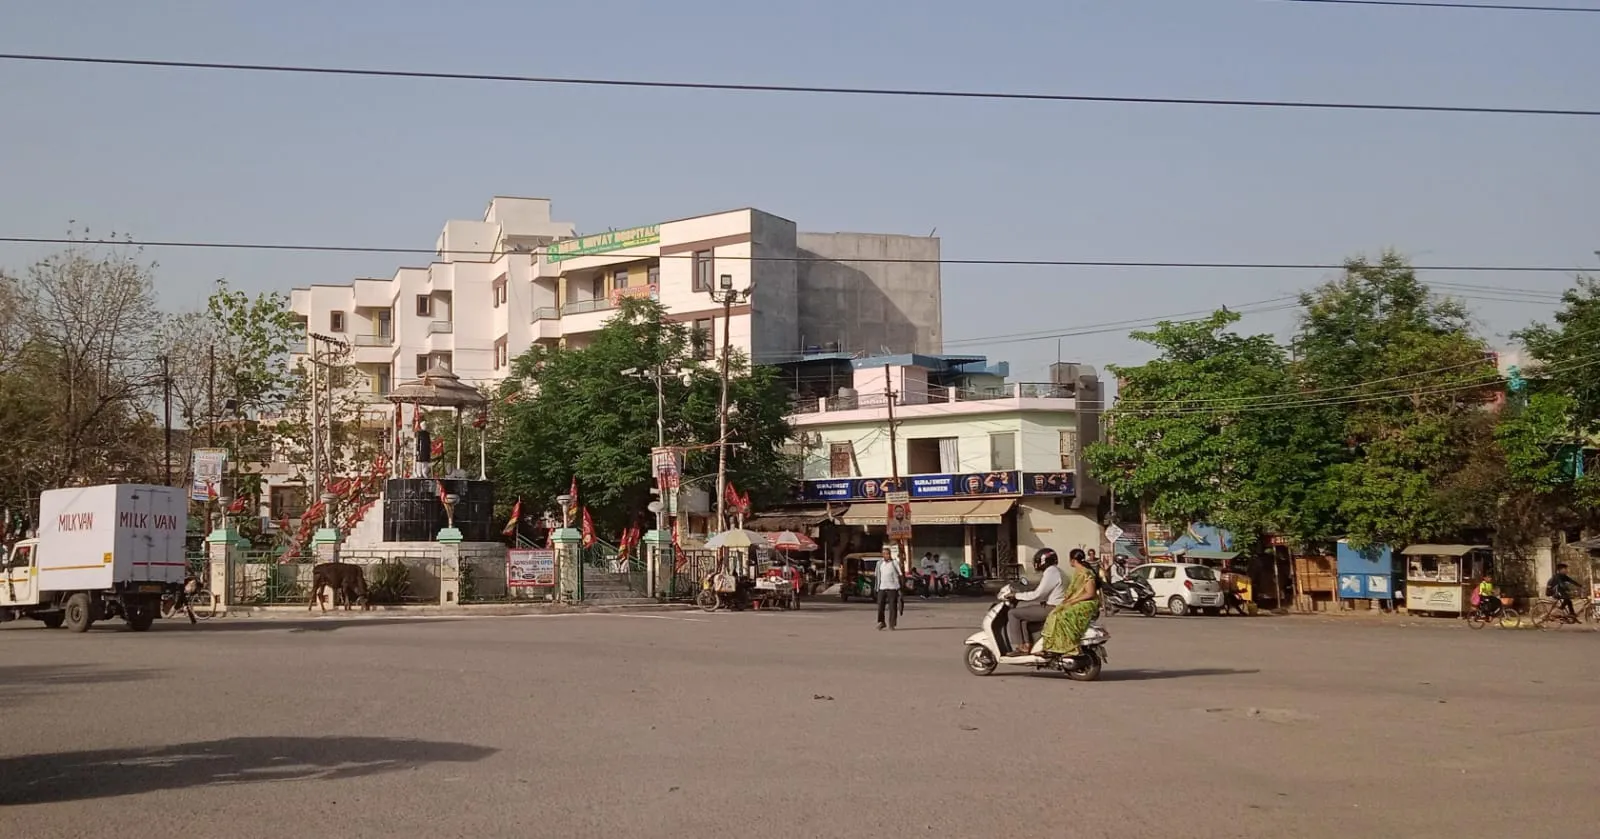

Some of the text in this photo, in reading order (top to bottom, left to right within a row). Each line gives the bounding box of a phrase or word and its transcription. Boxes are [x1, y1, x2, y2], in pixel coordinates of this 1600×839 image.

[58, 512, 94, 532] MILK VAN
[120, 511, 177, 530] MILK VAN
